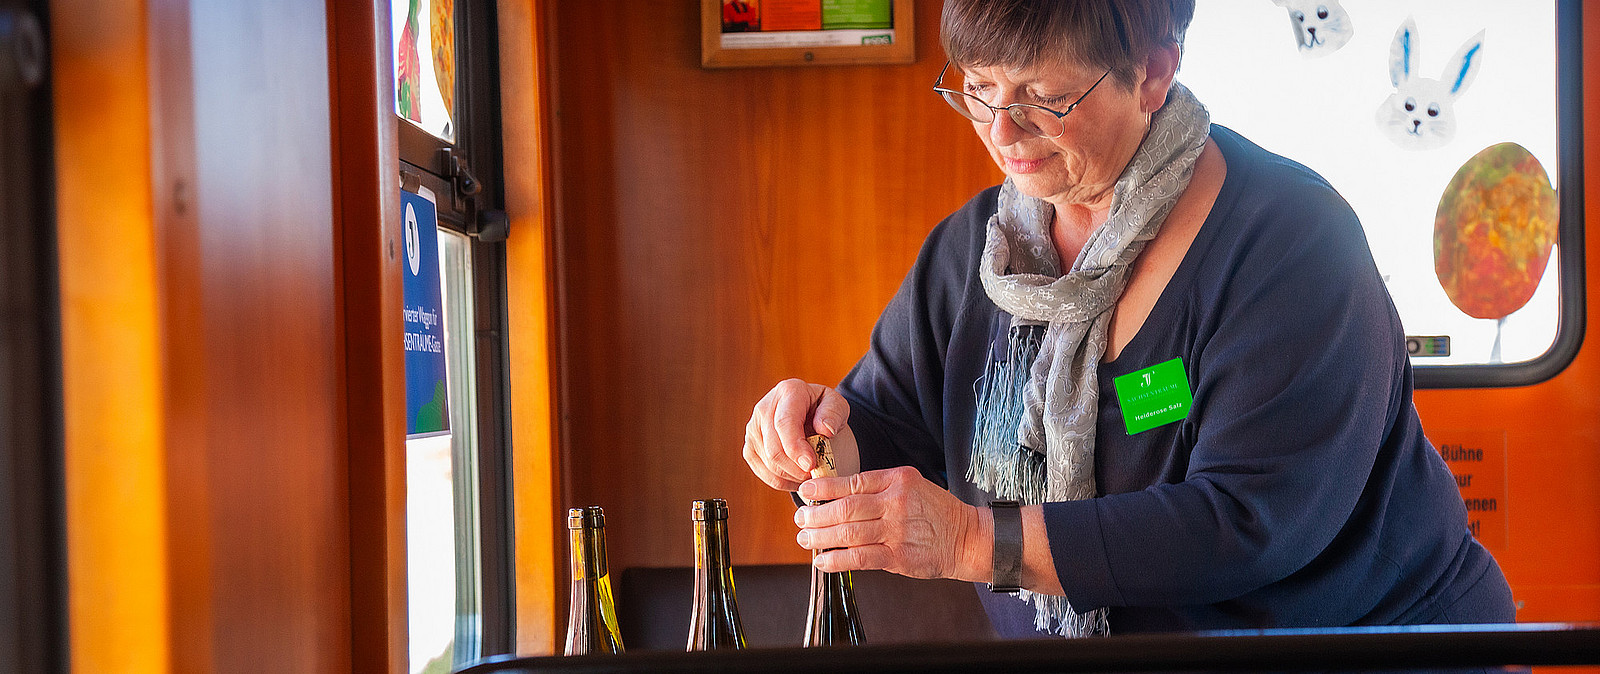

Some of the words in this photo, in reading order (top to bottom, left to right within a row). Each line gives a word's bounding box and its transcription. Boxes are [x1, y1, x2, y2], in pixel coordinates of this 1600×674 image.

[1135, 407, 1168, 421] Heiderose
[1168, 402, 1182, 411] Salz
[1440, 444, 1484, 462] Bühne
